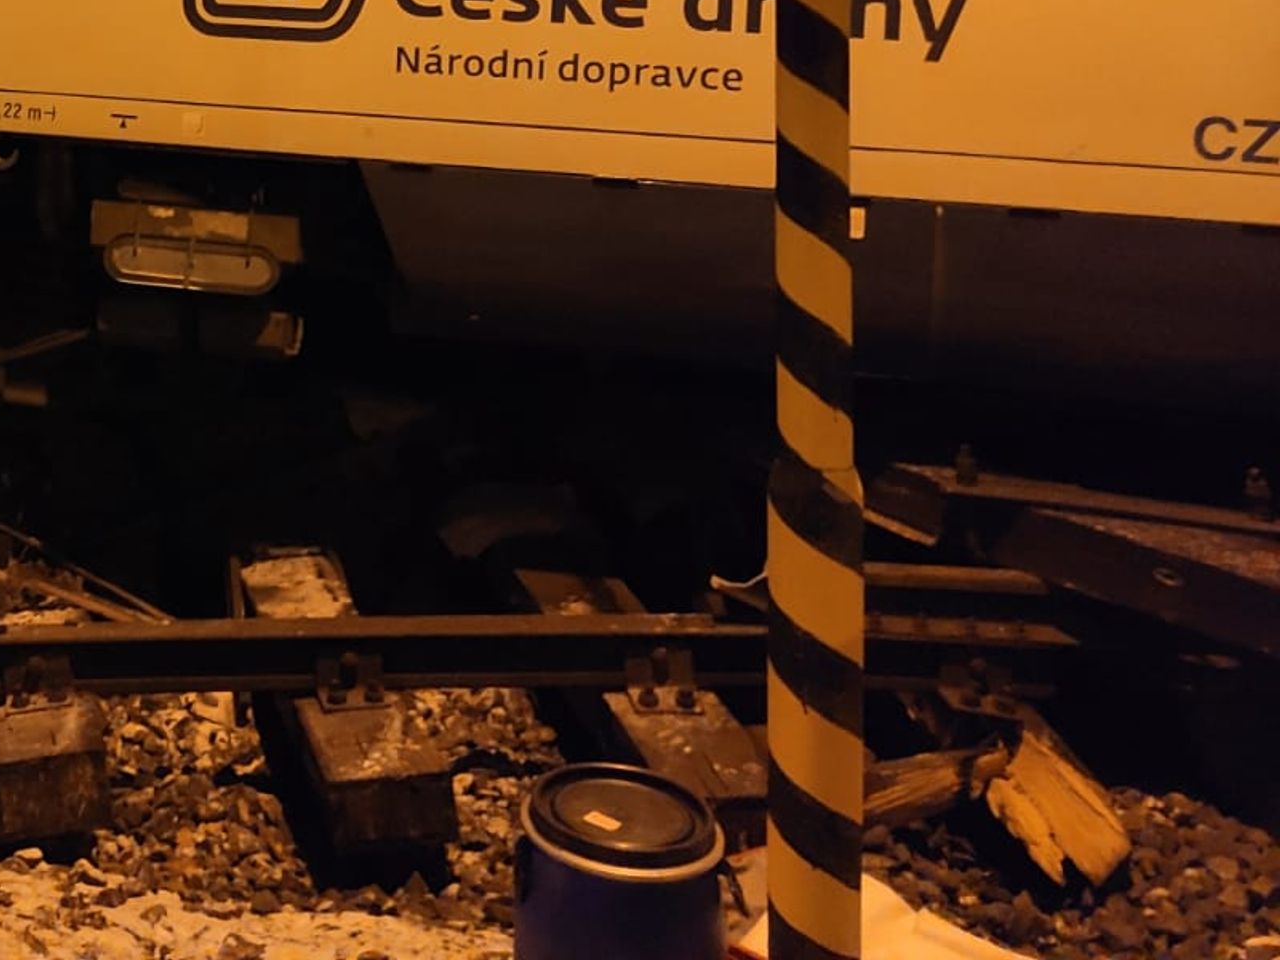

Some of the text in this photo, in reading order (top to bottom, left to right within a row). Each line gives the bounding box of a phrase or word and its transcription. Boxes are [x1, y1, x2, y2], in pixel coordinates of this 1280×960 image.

[396, 45, 743, 91] Národní dopravce
[27, 107, 41, 120] m
